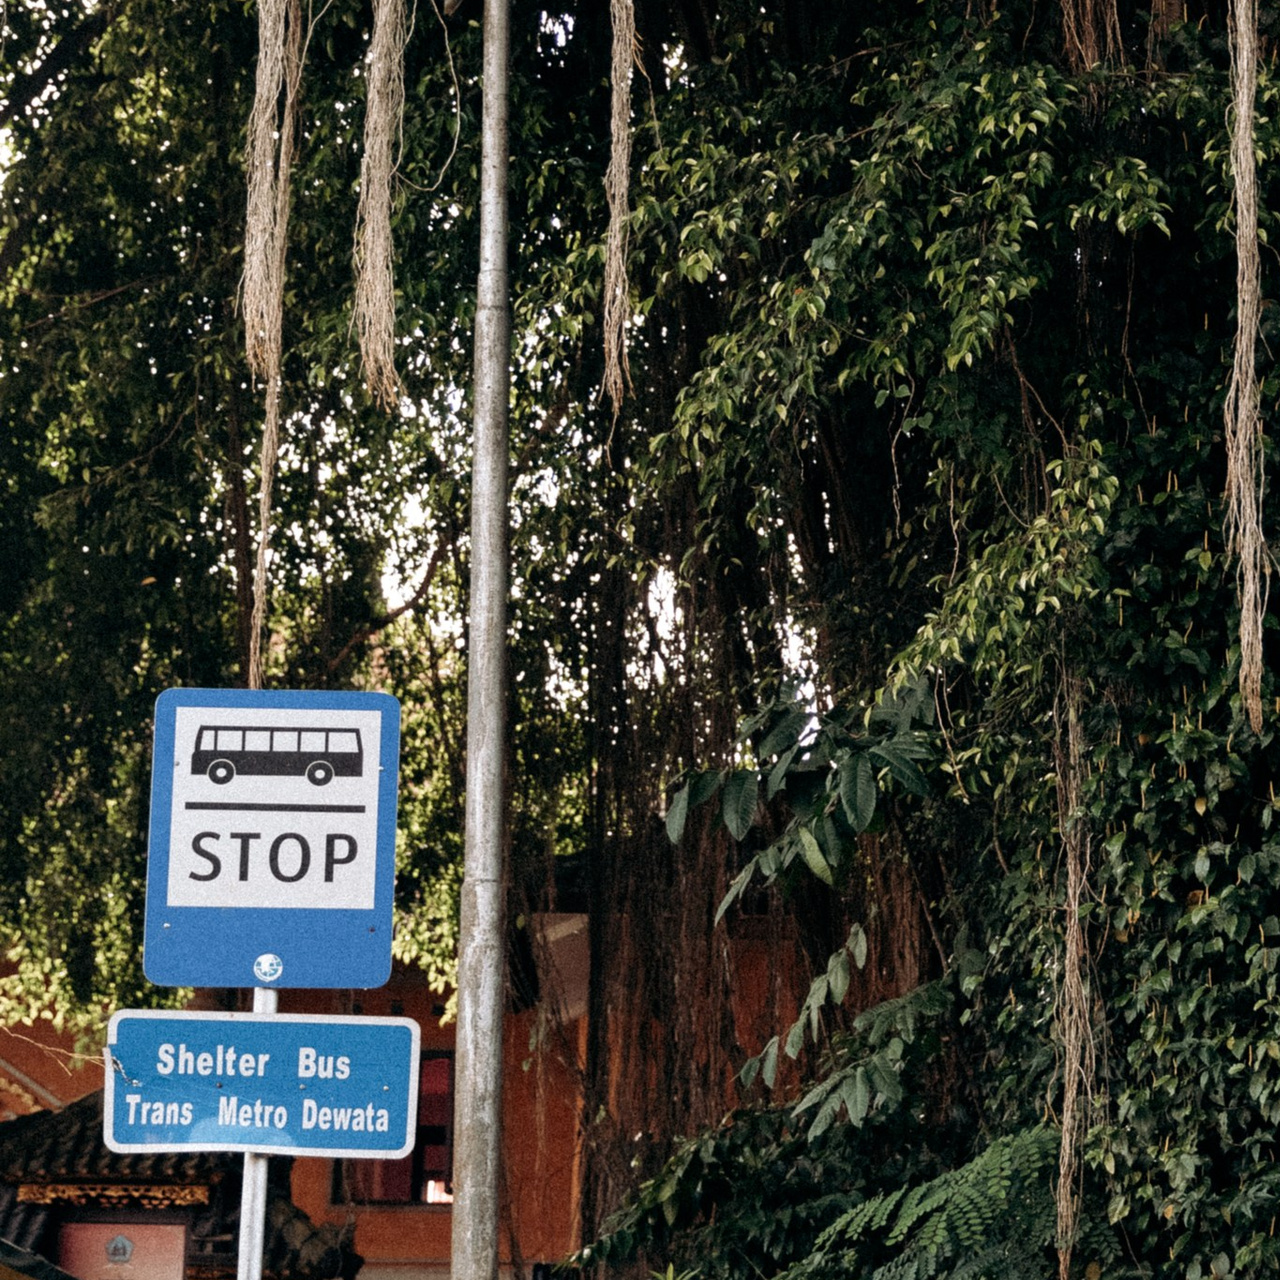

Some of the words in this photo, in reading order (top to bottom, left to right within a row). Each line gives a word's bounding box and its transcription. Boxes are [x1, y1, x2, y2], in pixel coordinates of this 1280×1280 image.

[189, 831, 359, 883] STOP
[156, 1043, 270, 1077] Shelter
[298, 1047, 351, 1080] Bus
[125, 1094, 193, 1126] Trans
[218, 1096, 288, 1130] Metro
[301, 1098, 390, 1133] Dewata
